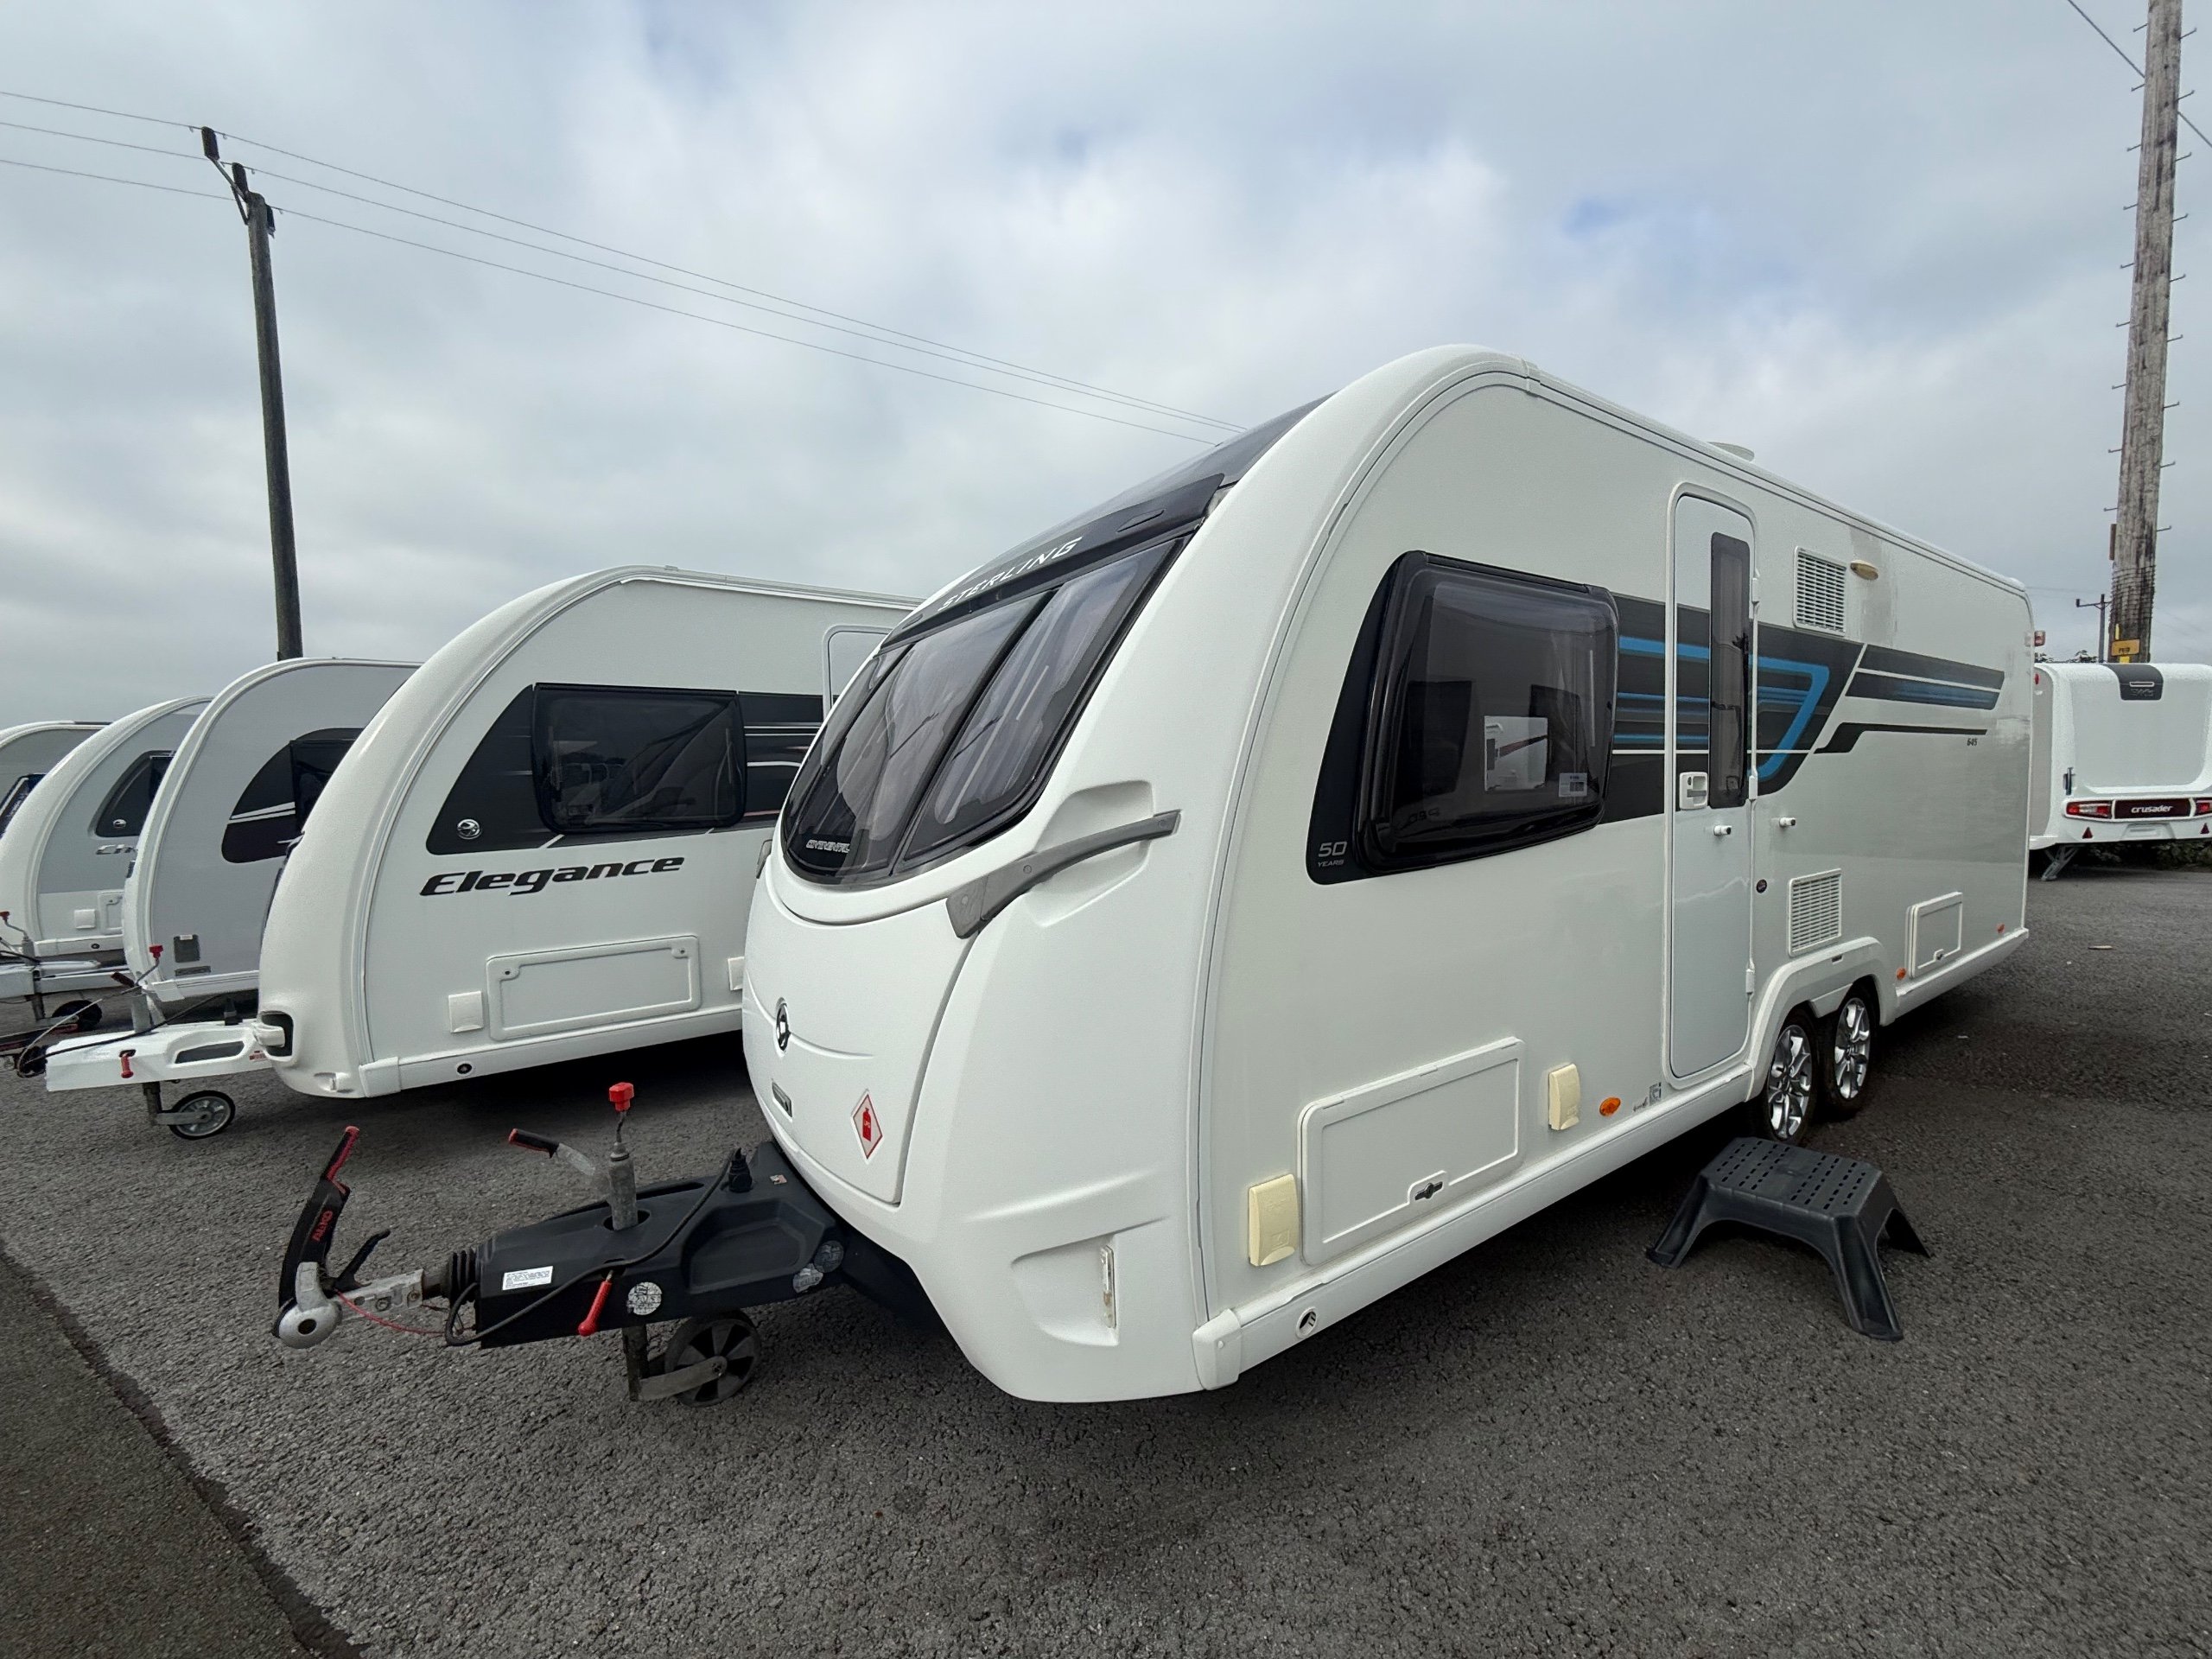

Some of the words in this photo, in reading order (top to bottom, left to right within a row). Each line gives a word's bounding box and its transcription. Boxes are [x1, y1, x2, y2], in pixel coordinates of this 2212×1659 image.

[937, 536, 1084, 612] STERLING
[1967, 737, 1978, 747] 645
[2131, 804, 2174, 814] crusader
[1318, 841, 1348, 857] 50
[1318, 859, 1344, 868] YEARS
[419, 856, 685, 897] Elegance
